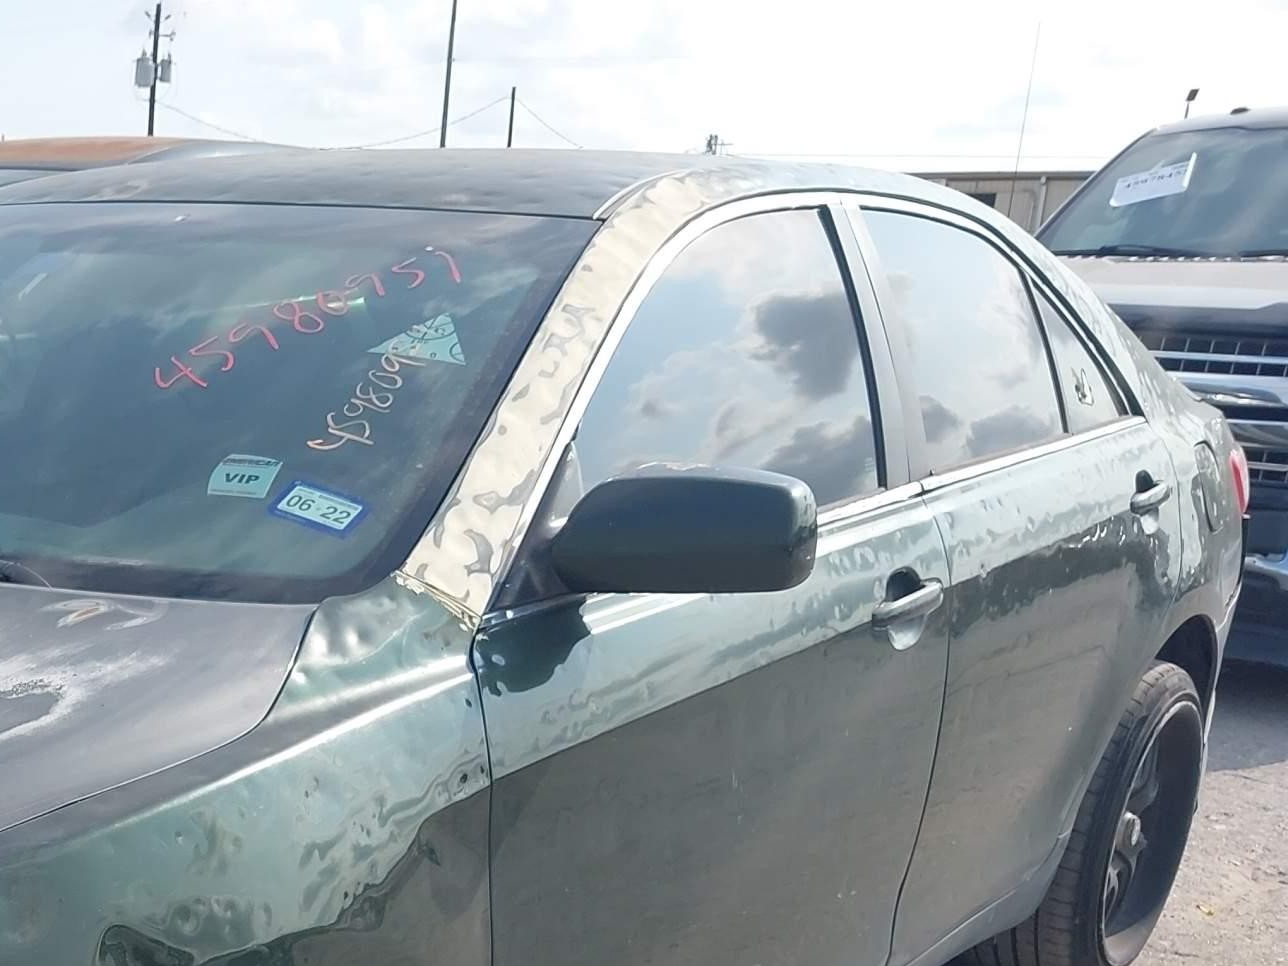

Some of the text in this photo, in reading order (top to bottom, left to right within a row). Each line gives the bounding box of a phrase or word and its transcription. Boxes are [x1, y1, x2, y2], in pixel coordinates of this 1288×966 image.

[224, 473, 260, 485] VIP
[285, 494, 316, 512] 06
[319, 505, 352, 525] 22
